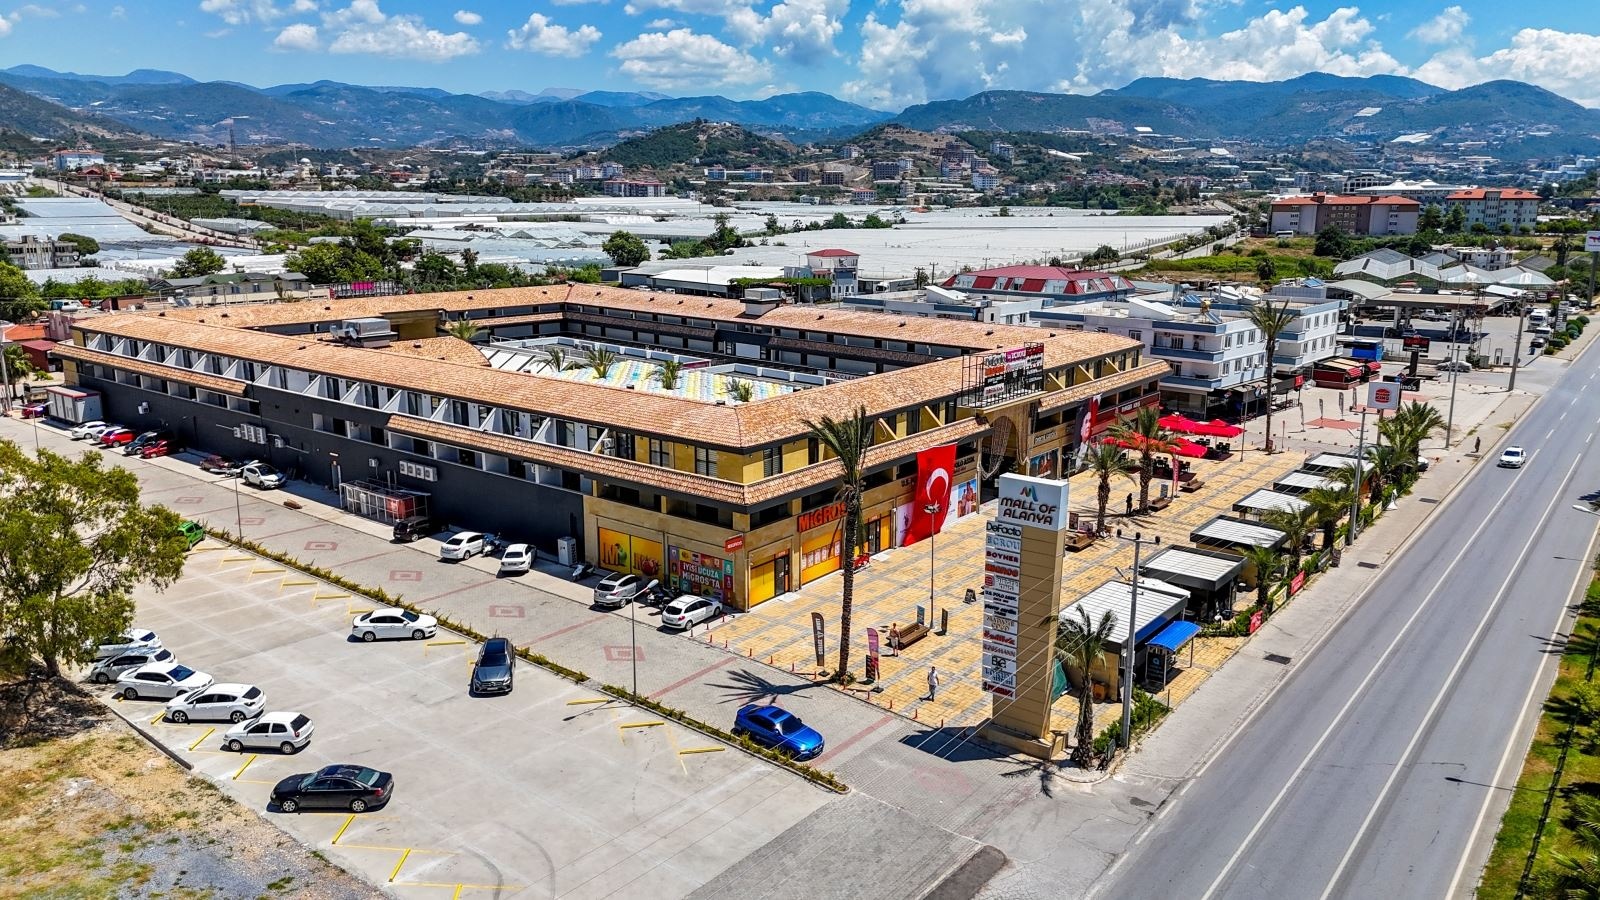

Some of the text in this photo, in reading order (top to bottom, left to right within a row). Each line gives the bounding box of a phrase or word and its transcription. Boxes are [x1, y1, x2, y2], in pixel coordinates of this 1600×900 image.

[1000, 497, 1057, 515] MALL OF
[1003, 508, 1053, 526] ALANYA
[986, 522, 1022, 537] DeFacto
[986, 550, 1019, 563] BOYNER
